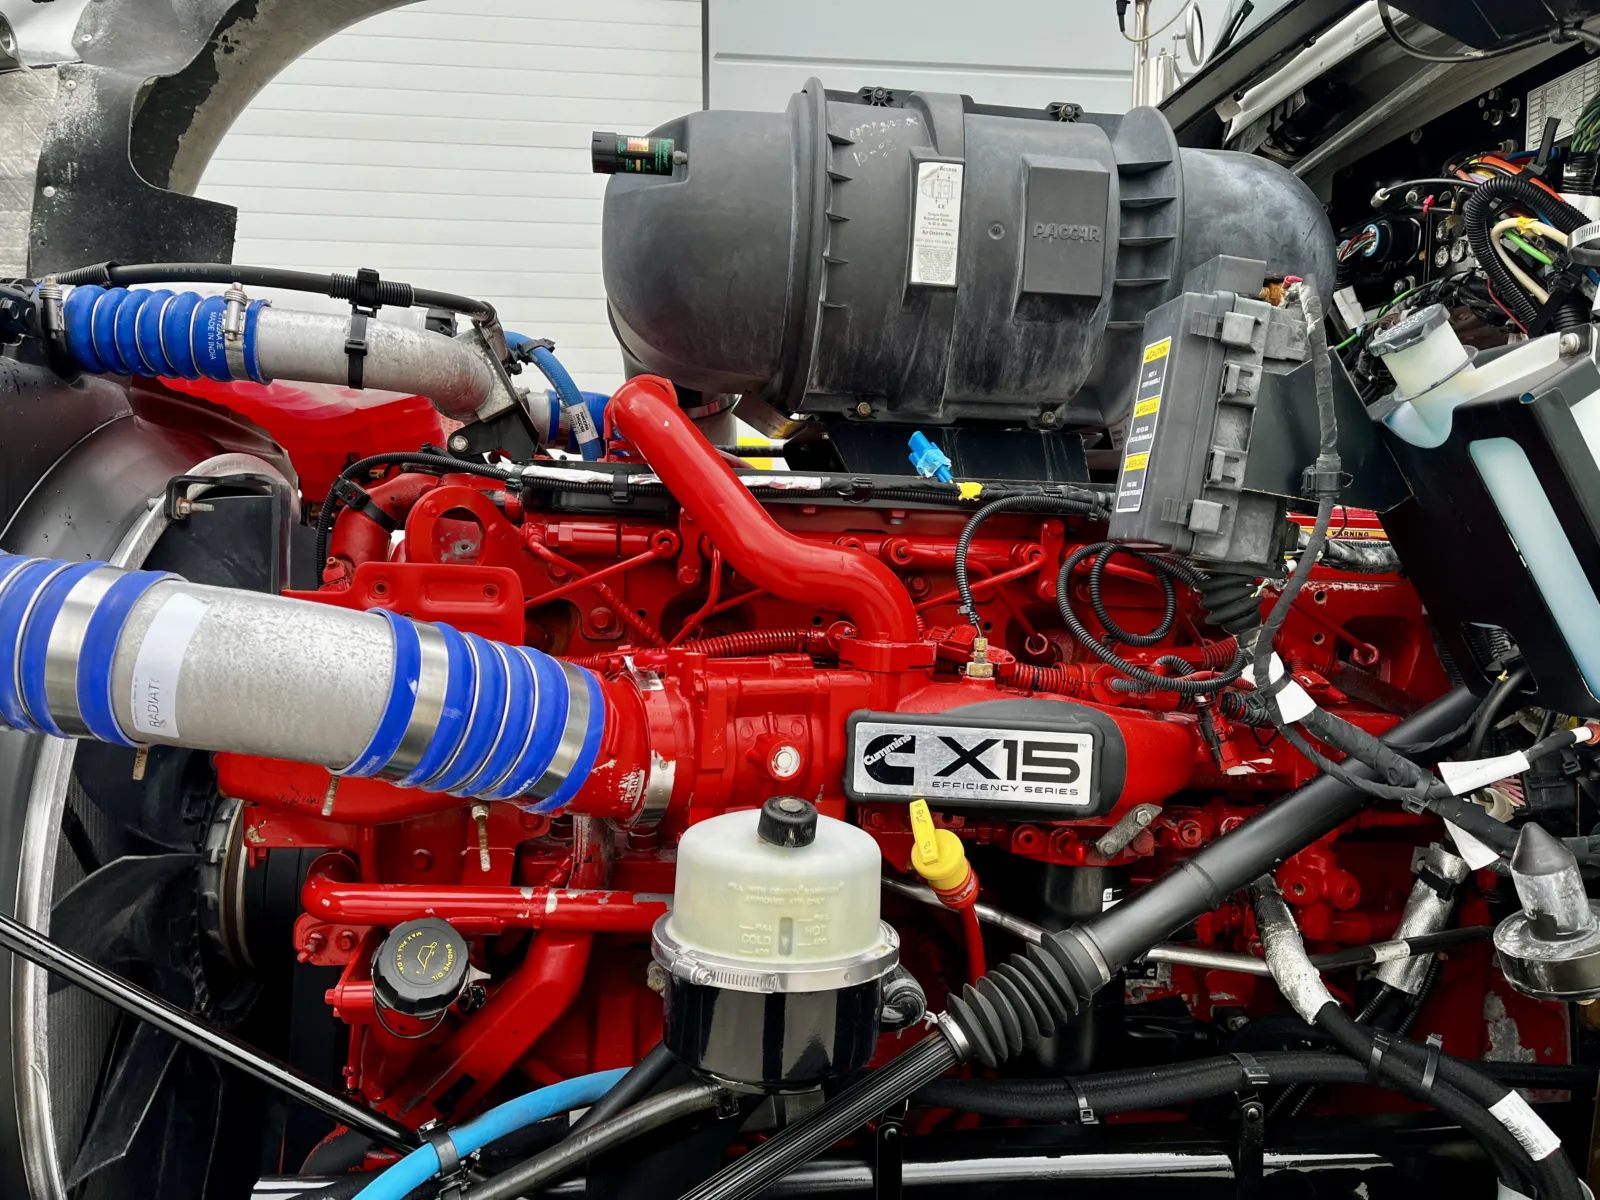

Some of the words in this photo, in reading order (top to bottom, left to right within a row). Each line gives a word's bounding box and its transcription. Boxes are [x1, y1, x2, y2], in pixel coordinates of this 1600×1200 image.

[1032, 223, 1101, 242] PACCAR
[208, 311, 217, 331] MADE
[208, 331, 215, 340] IN
[208, 341, 217, 360] INDIA
[863, 733, 912, 766] Cummins
[933, 735, 1081, 784] X15
[932, 781, 1019, 793] EFFICIENCY
[1024, 786, 1079, 796] SERIES
[407, 931, 423, 941] MAX
[805, 925, 827, 936] HOT
[741, 933, 772, 945] COLD
[397, 940, 408, 953] FILL
[443, 943, 454, 972] ENGINE
[397, 961, 405, 975] GAL
[430, 971, 444, 982] OIL
